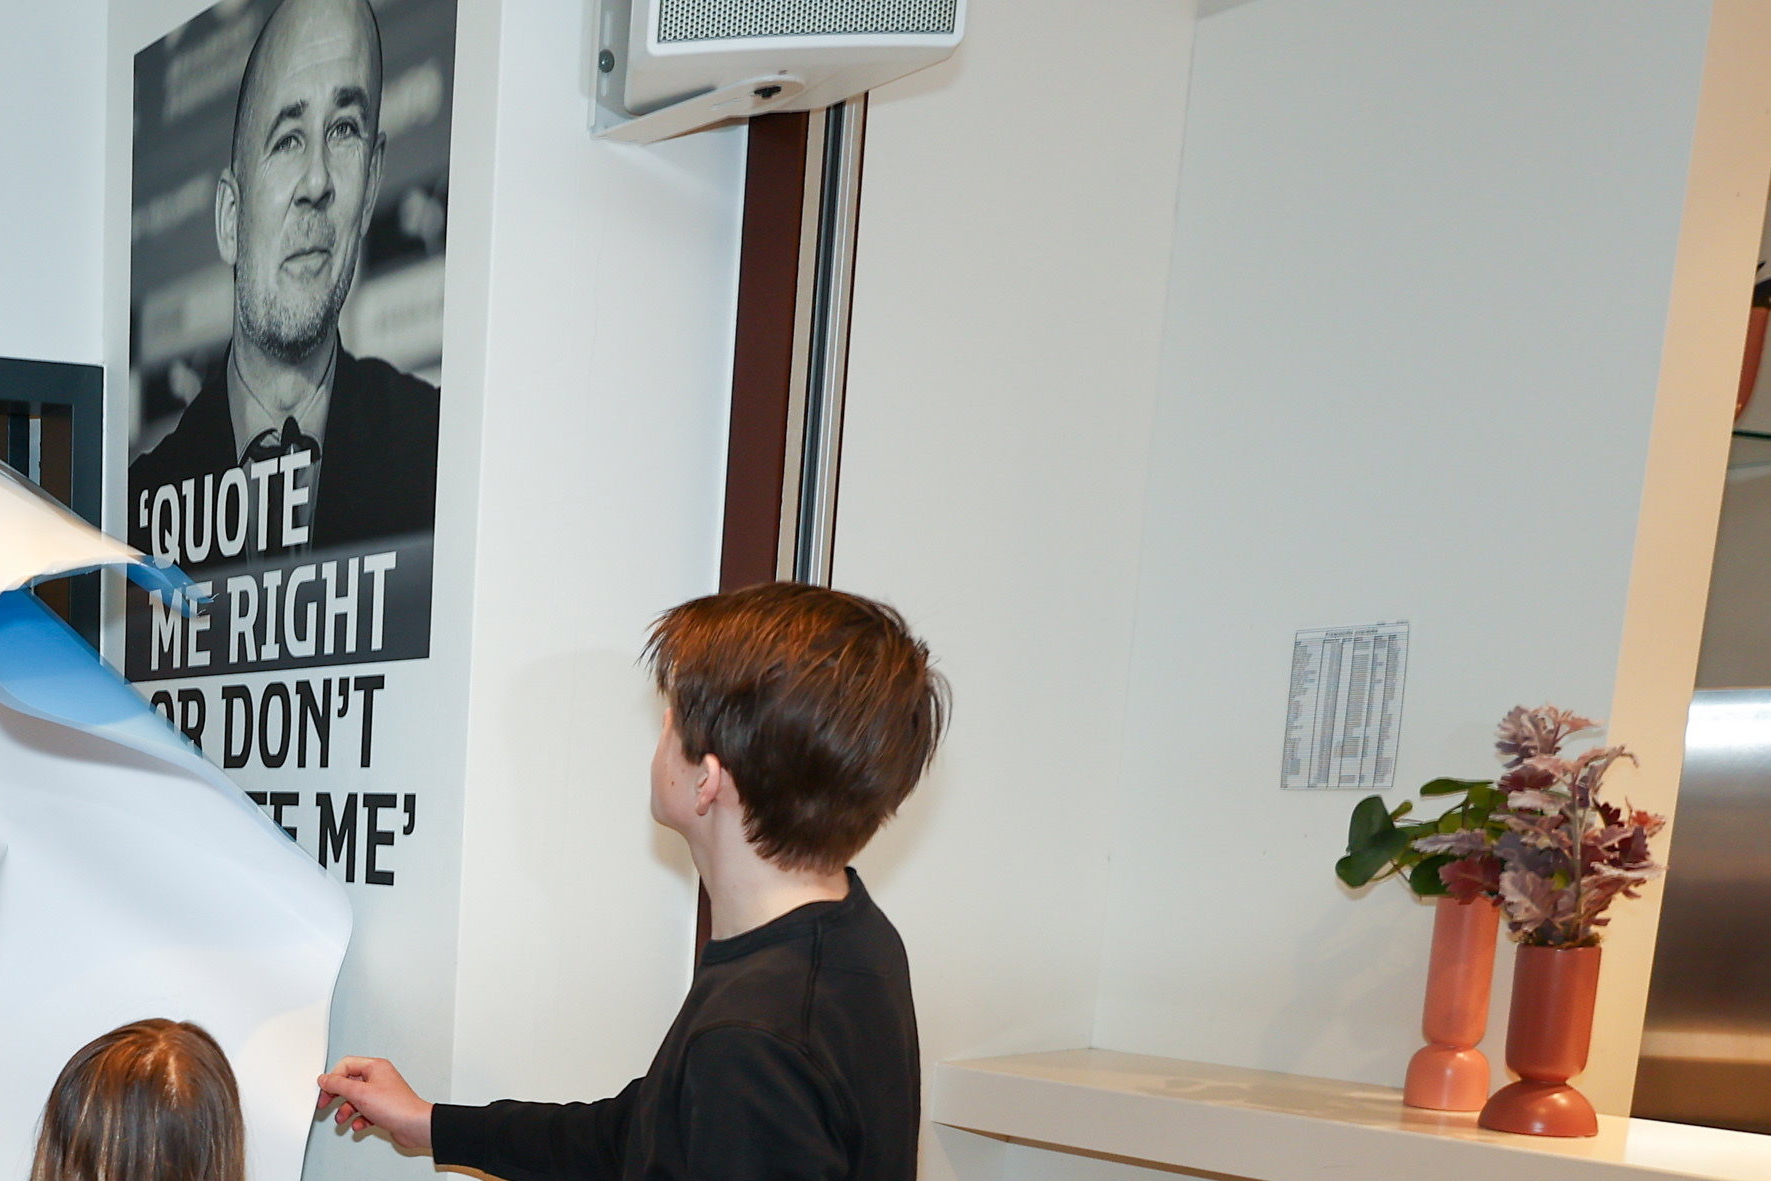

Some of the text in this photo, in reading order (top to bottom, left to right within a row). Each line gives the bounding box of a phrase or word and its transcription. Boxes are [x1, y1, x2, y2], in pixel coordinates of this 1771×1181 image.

[149, 551, 397, 671] ME RIGHT
[222, 674, 385, 768] DON’T
